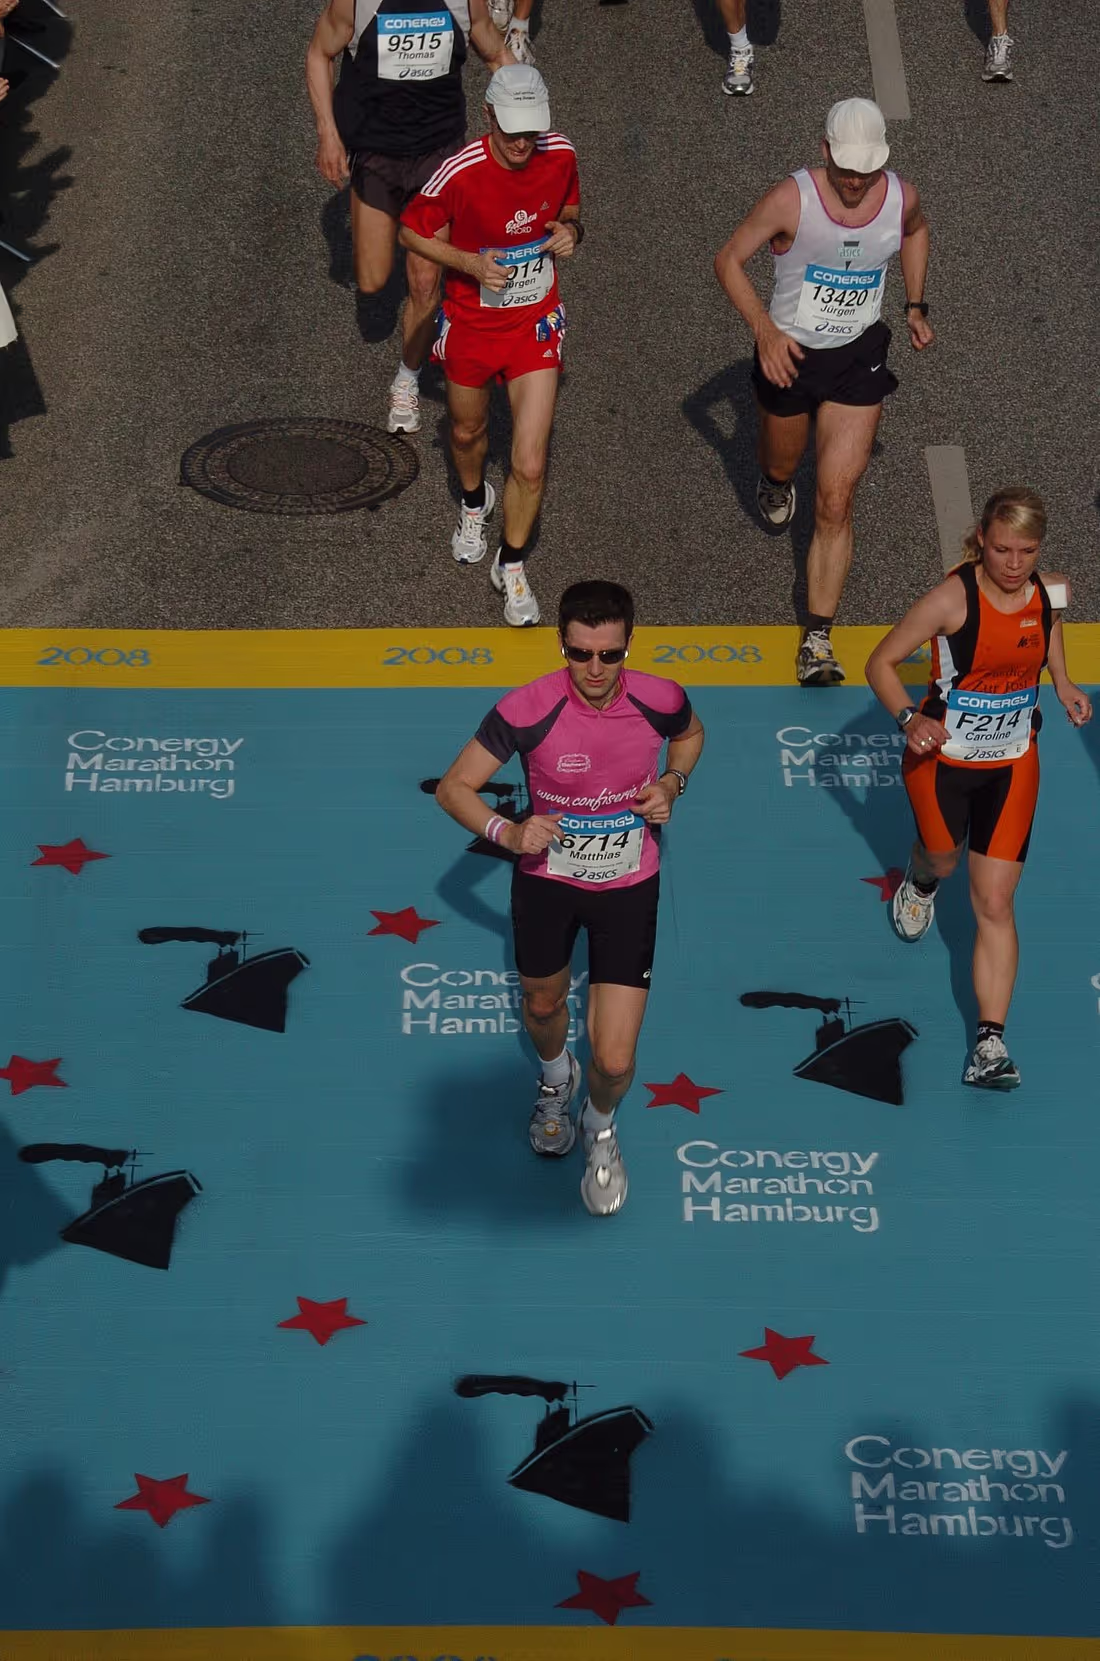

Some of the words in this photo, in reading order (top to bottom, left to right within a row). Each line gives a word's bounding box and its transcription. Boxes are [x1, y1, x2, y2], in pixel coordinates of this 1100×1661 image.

[385, 17, 446, 29] CONERGY
[387, 32, 443, 52] 9515
[399, 52, 435, 60] Thomas
[410, 68, 434, 77] asics
[506, 245, 541, 260] NERG
[813, 270, 875, 285] CONERGY
[513, 293, 538, 304] asics
[813, 285, 869, 307] 13420
[820, 304, 856, 317] Jürgen
[828, 323, 853, 334] asics
[36, 646, 152, 667] 2008
[383, 646, 494, 666] 2008
[652, 644, 762, 663] 2008
[957, 694, 1030, 709] CONERGY
[955, 709, 1022, 732] F214
[67, 730, 244, 757] Conergy
[775, 726, 907, 747] Coner
[965, 731, 1011, 741] Caroline
[66, 753, 235, 772] Marathon
[780, 749, 902, 766] Marath
[978, 748, 1007, 759] asics
[65, 772, 235, 799] Hamburg
[783, 768, 905, 787] Hamb
[557, 814, 635, 829] CONERGY
[560, 830, 630, 852] 6714
[569, 851, 622, 861] Matthias
[587, 868, 618, 880] asics
[400, 963, 588, 991] Coney
[402, 1012, 584, 1042] Hambg
[677, 1140, 879, 1175] Conergy
[682, 1170, 873, 1195] Marathon
[683, 1196, 879, 1232] Hamburg
[845, 1435, 1068, 1479] Conergy
[852, 1471, 1065, 1503] Marathon
[855, 1503, 1074, 1548] Hamburg
